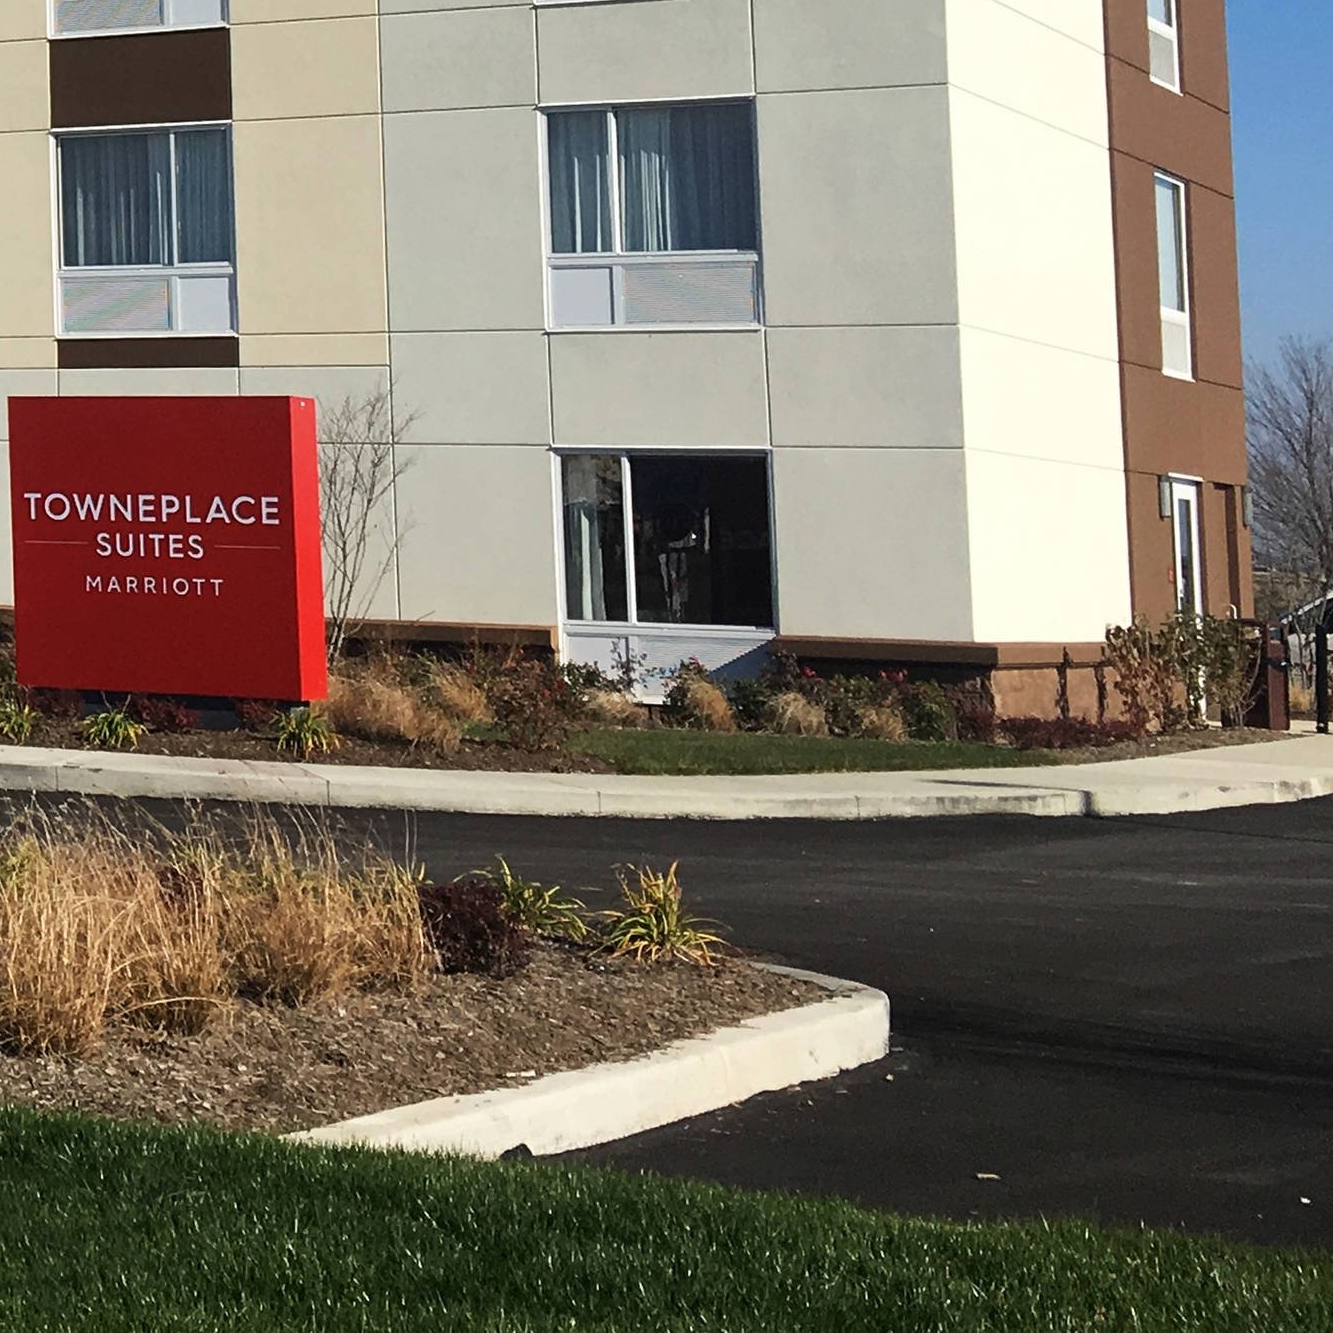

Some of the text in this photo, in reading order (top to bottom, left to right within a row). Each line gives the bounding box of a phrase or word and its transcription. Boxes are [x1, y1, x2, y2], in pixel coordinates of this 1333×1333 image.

[23, 492, 281, 525] TOWNEPLACE
[95, 532, 205, 559] SUITES
[85, 575, 224, 597] MARRIOTT
